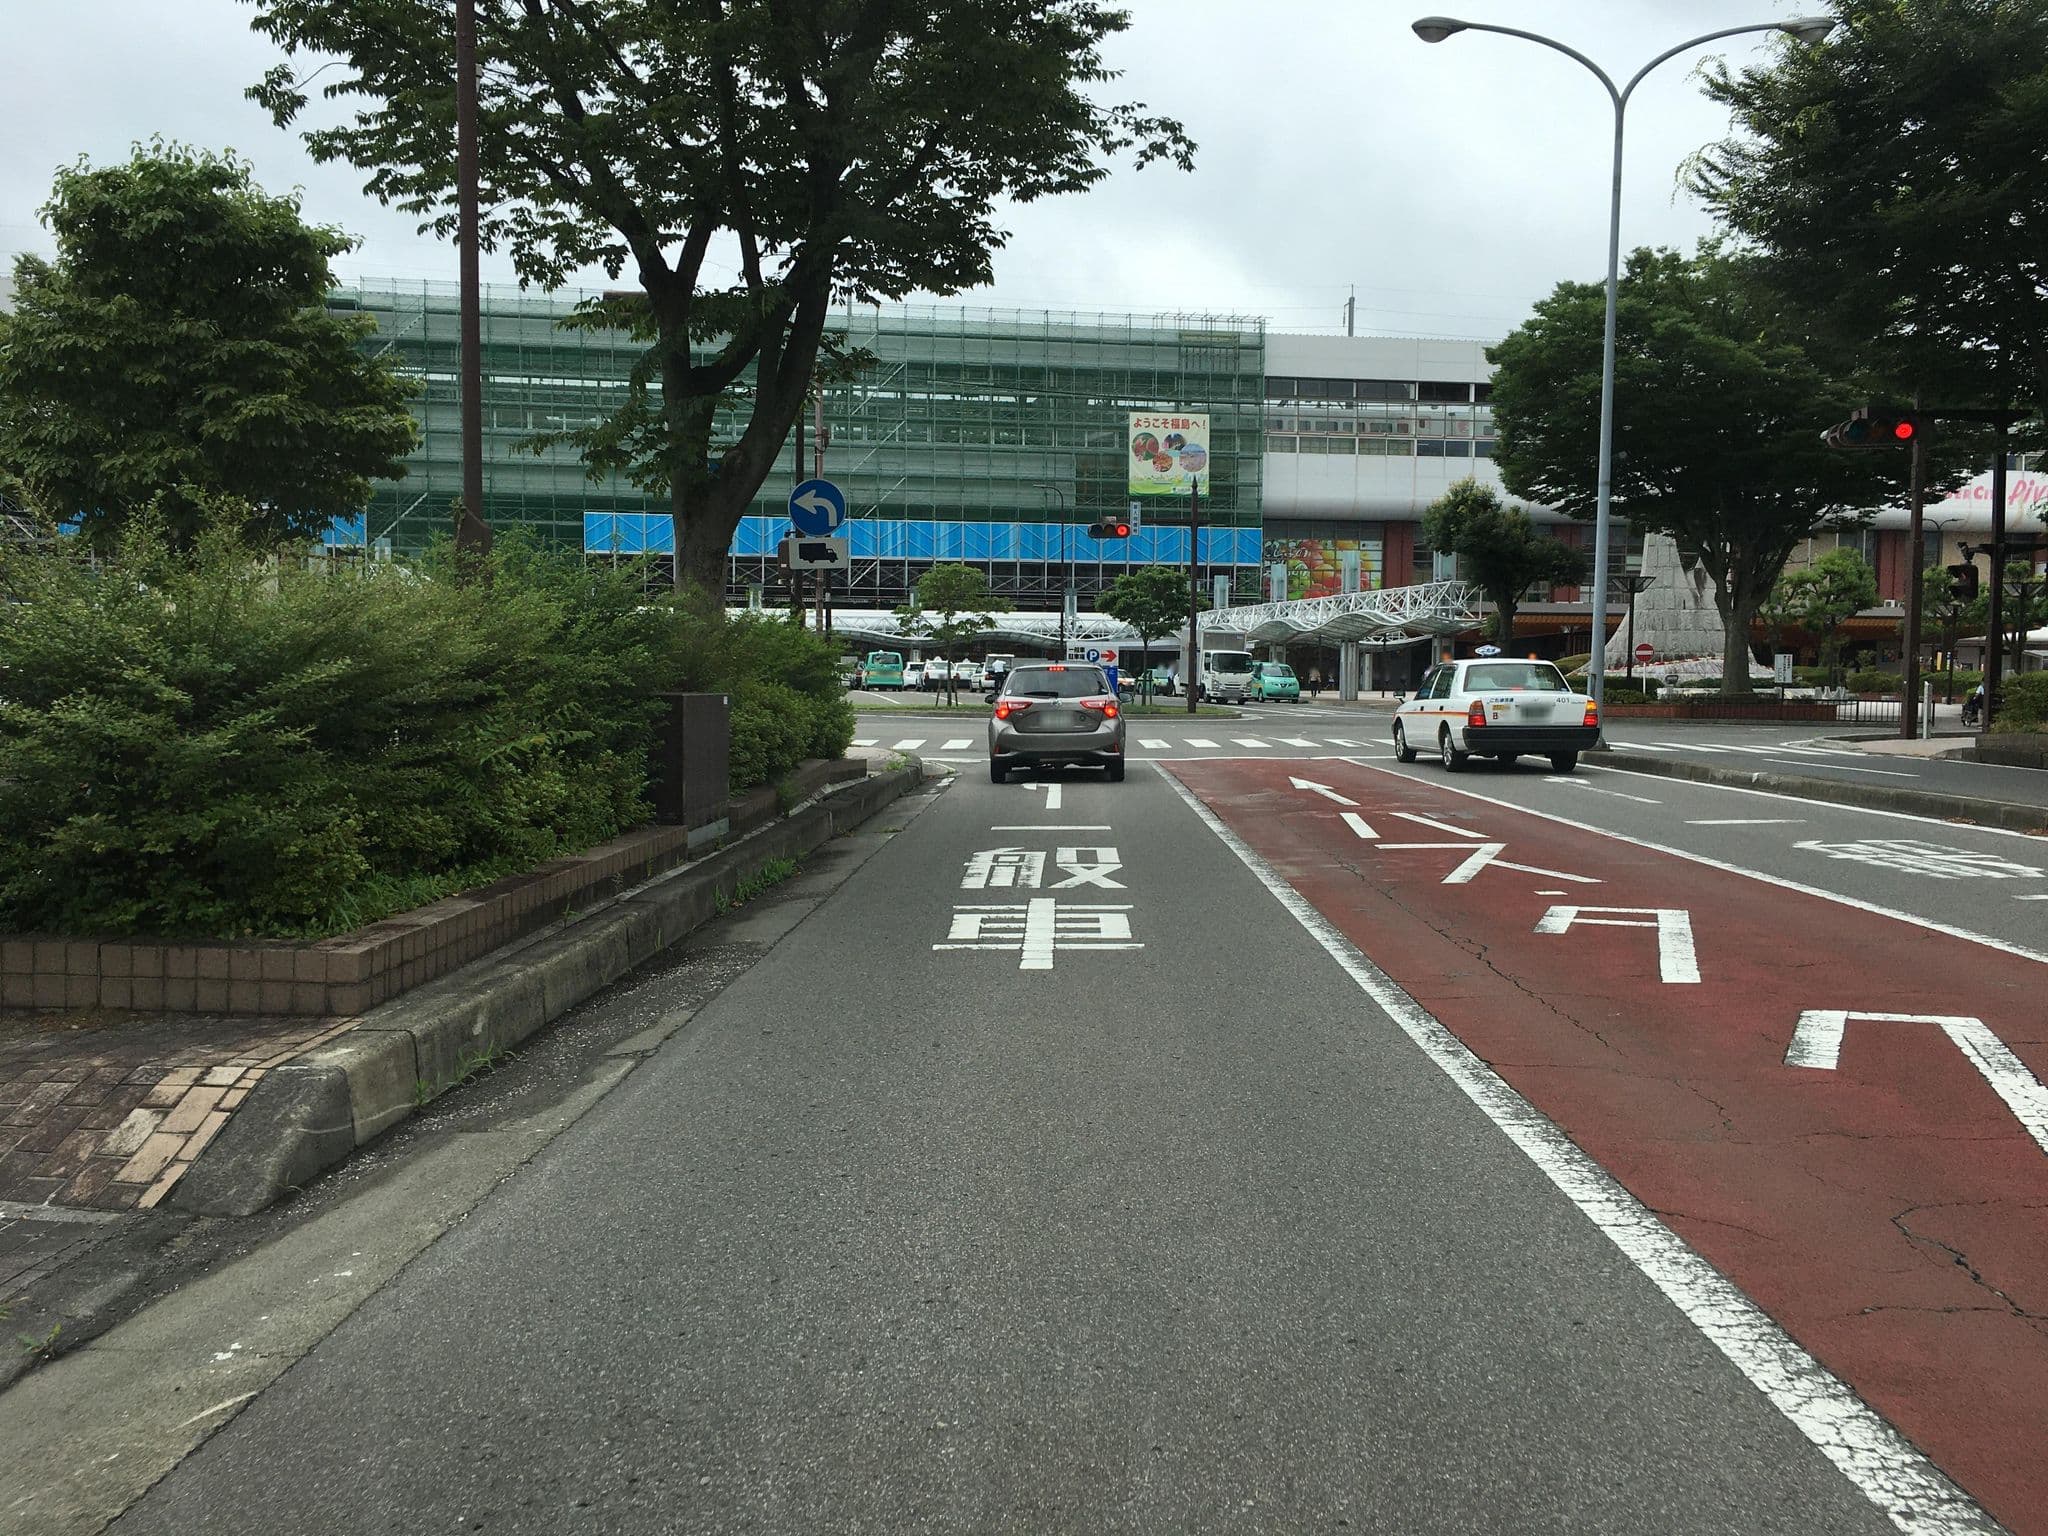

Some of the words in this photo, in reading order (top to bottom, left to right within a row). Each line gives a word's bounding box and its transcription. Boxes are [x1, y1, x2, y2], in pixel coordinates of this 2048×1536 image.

[1133, 417, 1206, 430] ようこそ福島へ！
